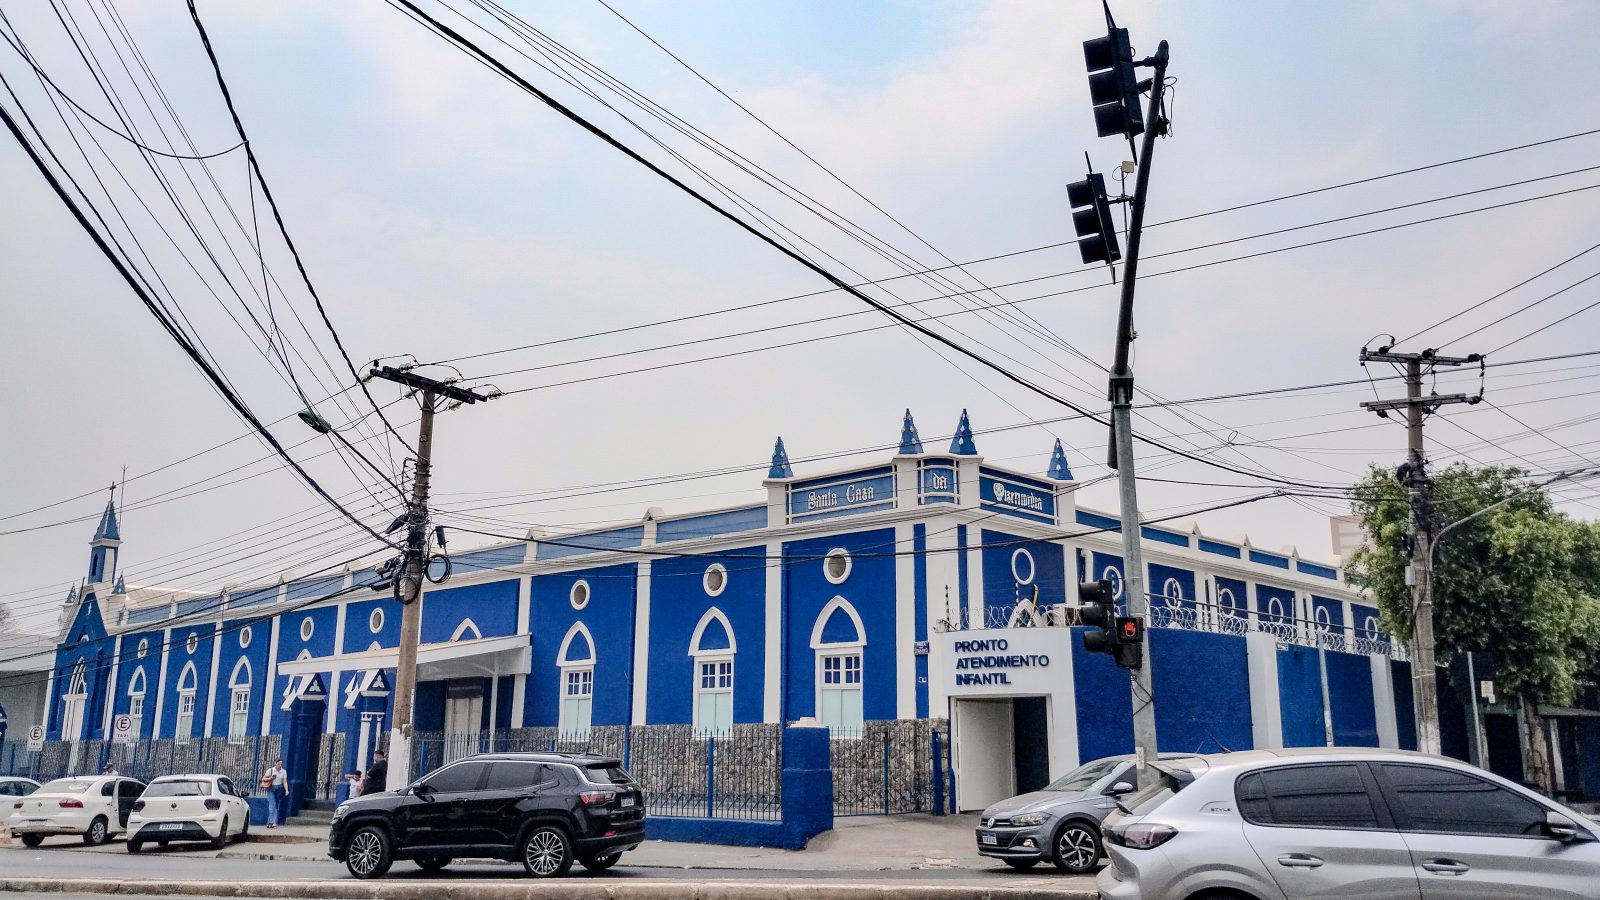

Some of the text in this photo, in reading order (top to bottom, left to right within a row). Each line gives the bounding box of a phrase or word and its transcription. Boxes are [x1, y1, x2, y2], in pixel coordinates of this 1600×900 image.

[932, 472, 947, 490] da
[808, 489, 837, 509] Santa
[954, 639, 1008, 653] PRONTO
[955, 655, 1050, 669] ATENDIMENTO
[955, 673, 1012, 685] INFANTIL
[120, 718, 128, 728] E
[33, 728, 40, 738] E
